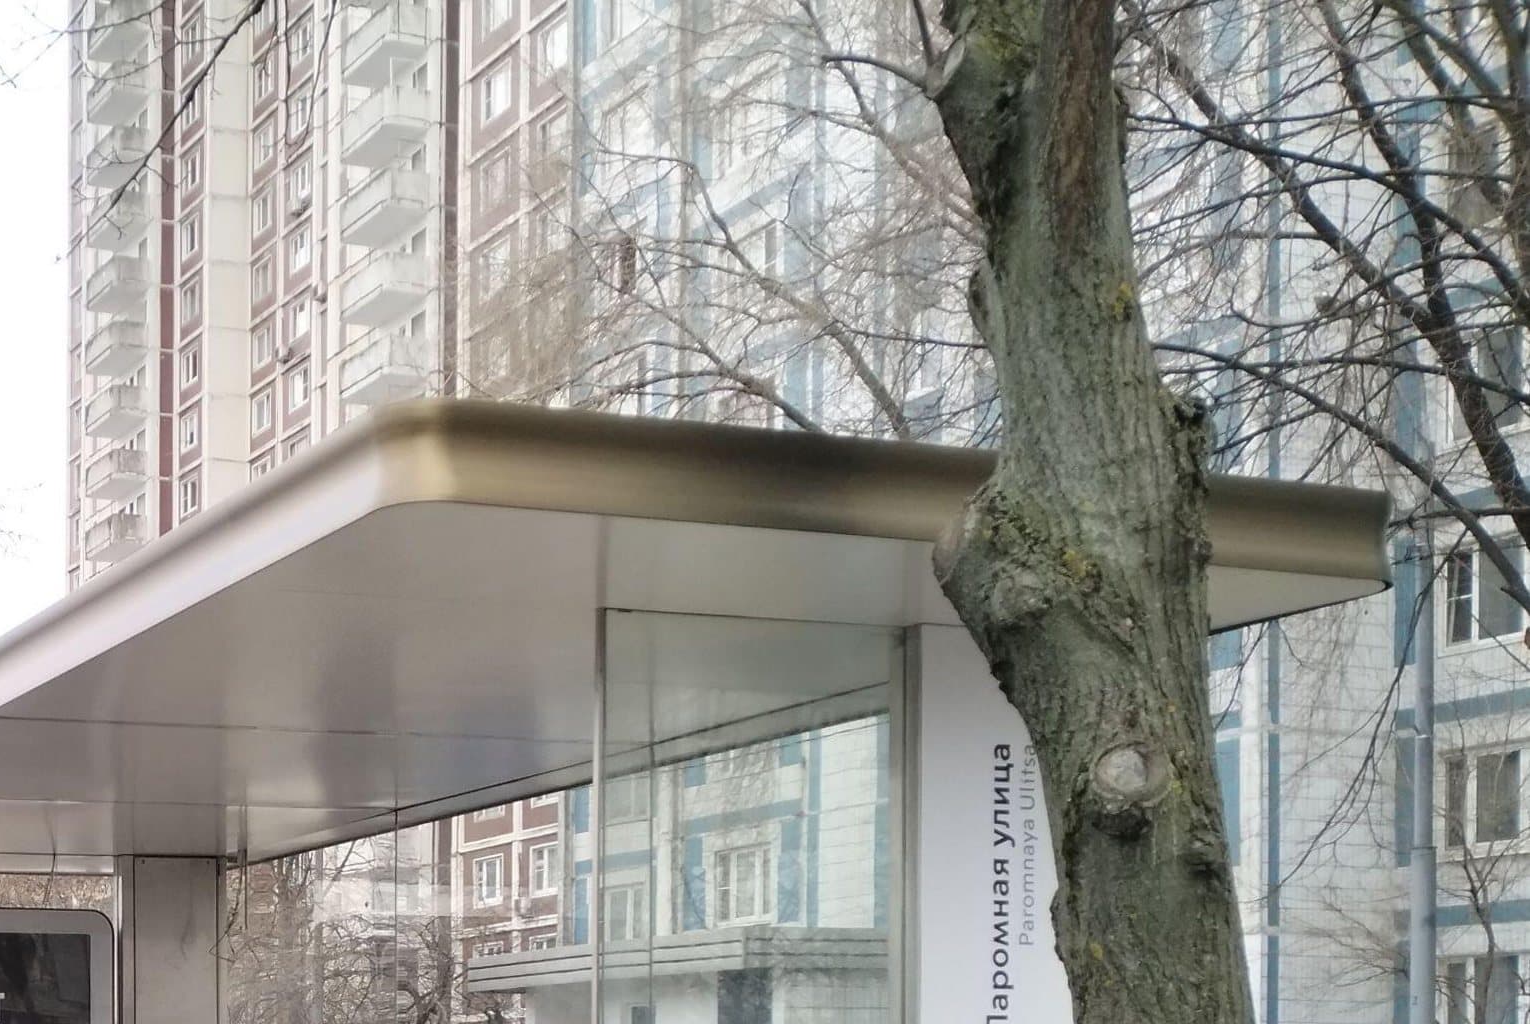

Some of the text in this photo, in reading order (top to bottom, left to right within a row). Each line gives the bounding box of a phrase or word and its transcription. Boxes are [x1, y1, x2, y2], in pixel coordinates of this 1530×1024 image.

[993, 743, 1015, 848] улица
[1018, 744, 1038, 946] Paromnaya Ulitsa
